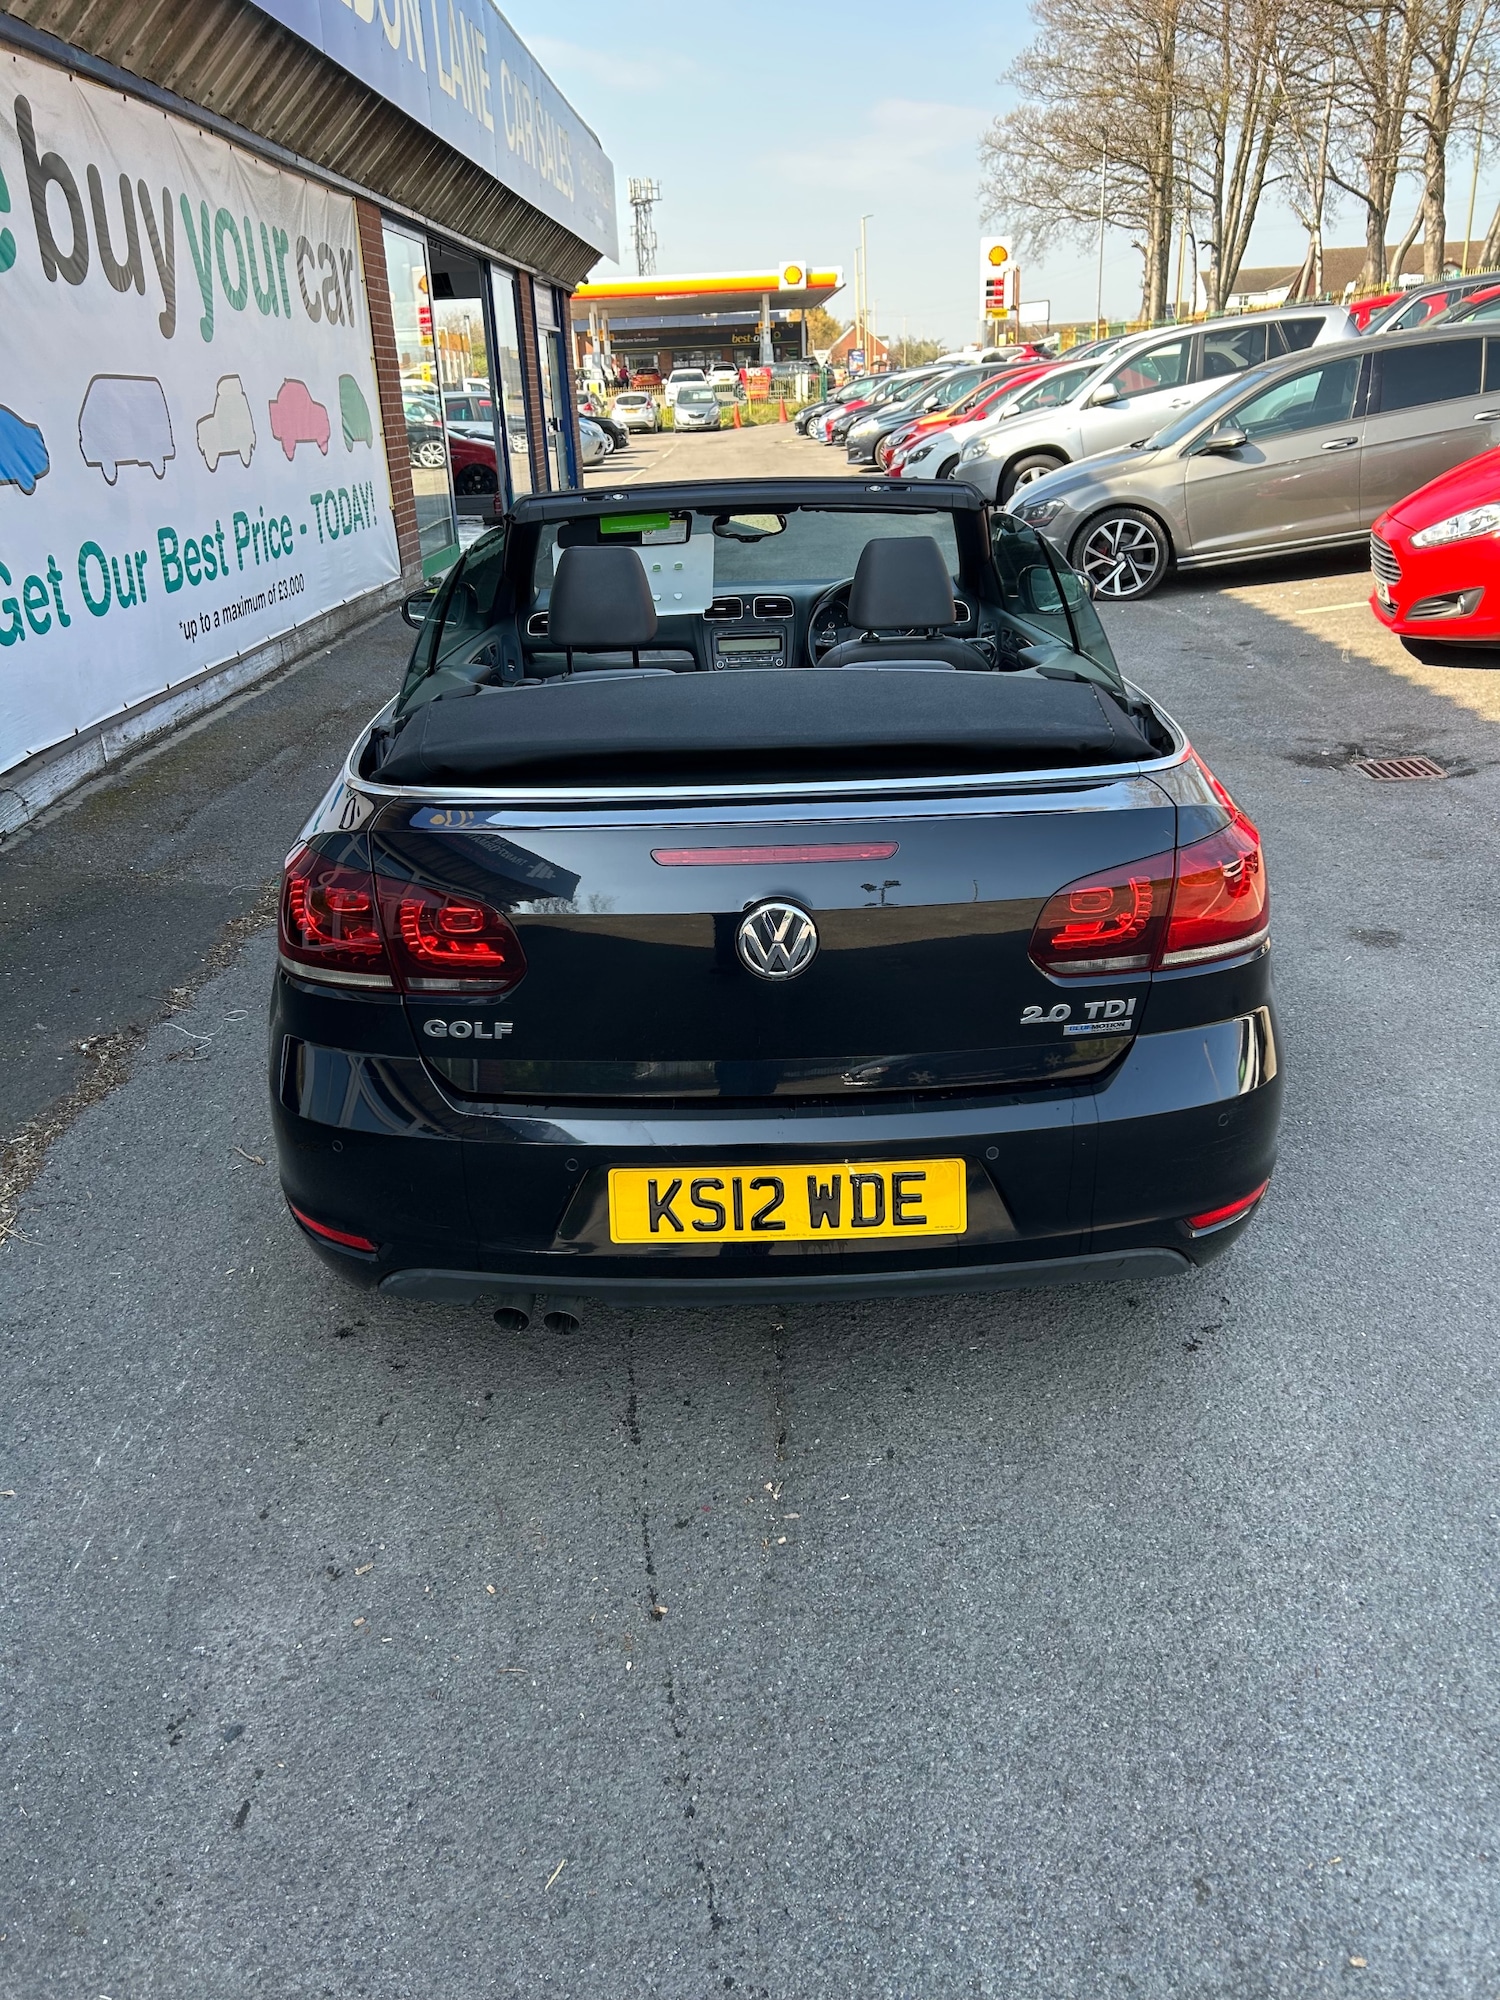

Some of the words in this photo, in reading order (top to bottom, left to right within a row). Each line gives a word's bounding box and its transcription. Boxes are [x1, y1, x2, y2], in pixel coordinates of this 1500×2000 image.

[431, 0, 494, 133] LANE
[500, 58, 537, 170] CAR
[535, 97, 574, 203] SALES
[0, 554, 72, 647] Get
[78, 540, 148, 617] Our
[157, 519, 229, 594] Best
[232, 505, 294, 571] Price
[310, 480, 378, 544] TODAY!
[200, 612, 211, 633] to
[213, 611, 221, 628] a
[222, 592, 267, 625] maximum
[267, 583, 277, 604] of
[278, 573, 305, 601] £3,000
[422, 1018, 515, 1040] GOLF
[1084, 997, 1137, 1020] TDI
[648, 1176, 786, 1233] KS12
[807, 1170, 928, 1229] WDE
